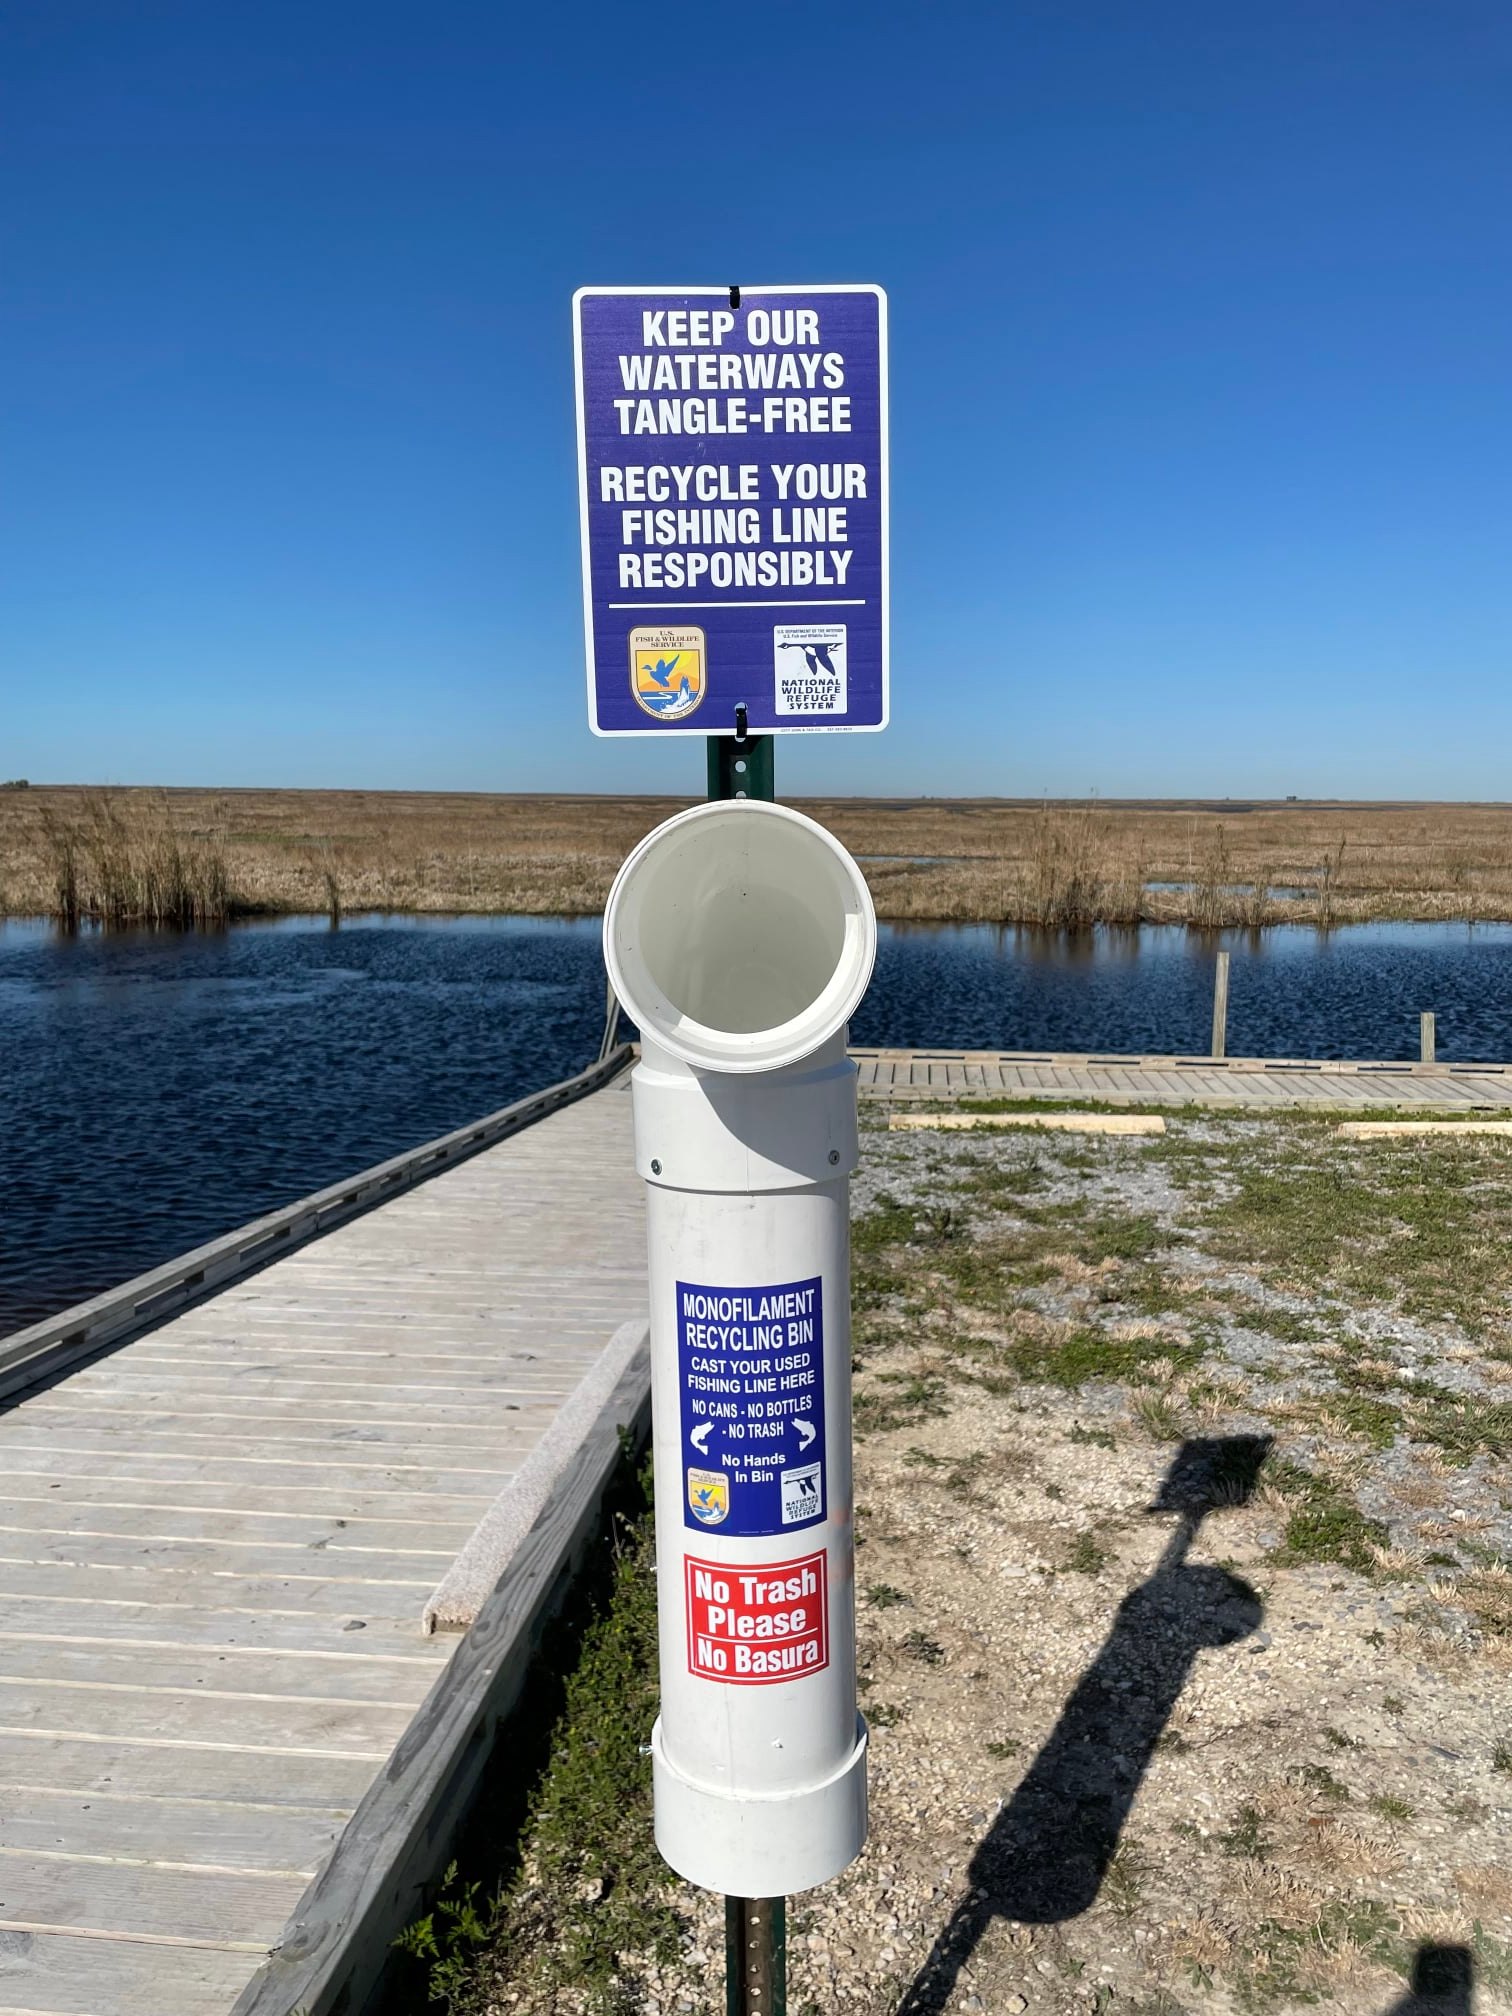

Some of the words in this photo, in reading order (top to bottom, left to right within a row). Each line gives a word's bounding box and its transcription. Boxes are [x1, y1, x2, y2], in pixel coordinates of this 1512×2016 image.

[643, 310, 735, 347] KEEP
[747, 309, 819, 346] OUR
[618, 352, 844, 391] WATERWAYS
[613, 396, 852, 435] TANGLE-FREE
[600, 464, 759, 502] RECYCLE
[770, 463, 867, 500] YOUR
[622, 507, 760, 545] FISHING
[772, 506, 848, 543] LINE
[618, 550, 853, 588] RESPONSIBLY
[781, 686, 841, 694] WILDLIFE
[786, 694, 837, 702] REFUGE
[789, 702, 834, 710] SYSTEM
[683, 1288, 815, 1322] MONOFILAMENT
[686, 1322, 783, 1351] RECYCLING
[787, 1318, 814, 1347] BIN
[691, 1356, 726, 1373] CAST
[729, 1359, 771, 1375] YOUR
[774, 1352, 811, 1372] USED
[687, 1374, 741, 1393] FISHING
[744, 1377, 777, 1393] LINE
[780, 1369, 815, 1390] HERE
[692, 1398, 707, 1415] NO
[708, 1401, 738, 1418] CANS
[747, 1403, 764, 1418] NO
[766, 1394, 812, 1417] BOTTLES
[728, 1423, 745, 1439] NO
[747, 1421, 784, 1438] TRASH
[721, 1453, 741, 1467] No
[743, 1452, 786, 1467] Hands
[735, 1471, 748, 1483] In
[751, 1470, 774, 1483] Bin
[694, 1569, 730, 1604] No
[739, 1567, 816, 1605] Trash
[708, 1605, 806, 1638] Please
[697, 1638, 727, 1672] No
[734, 1639, 818, 1674] Basura
